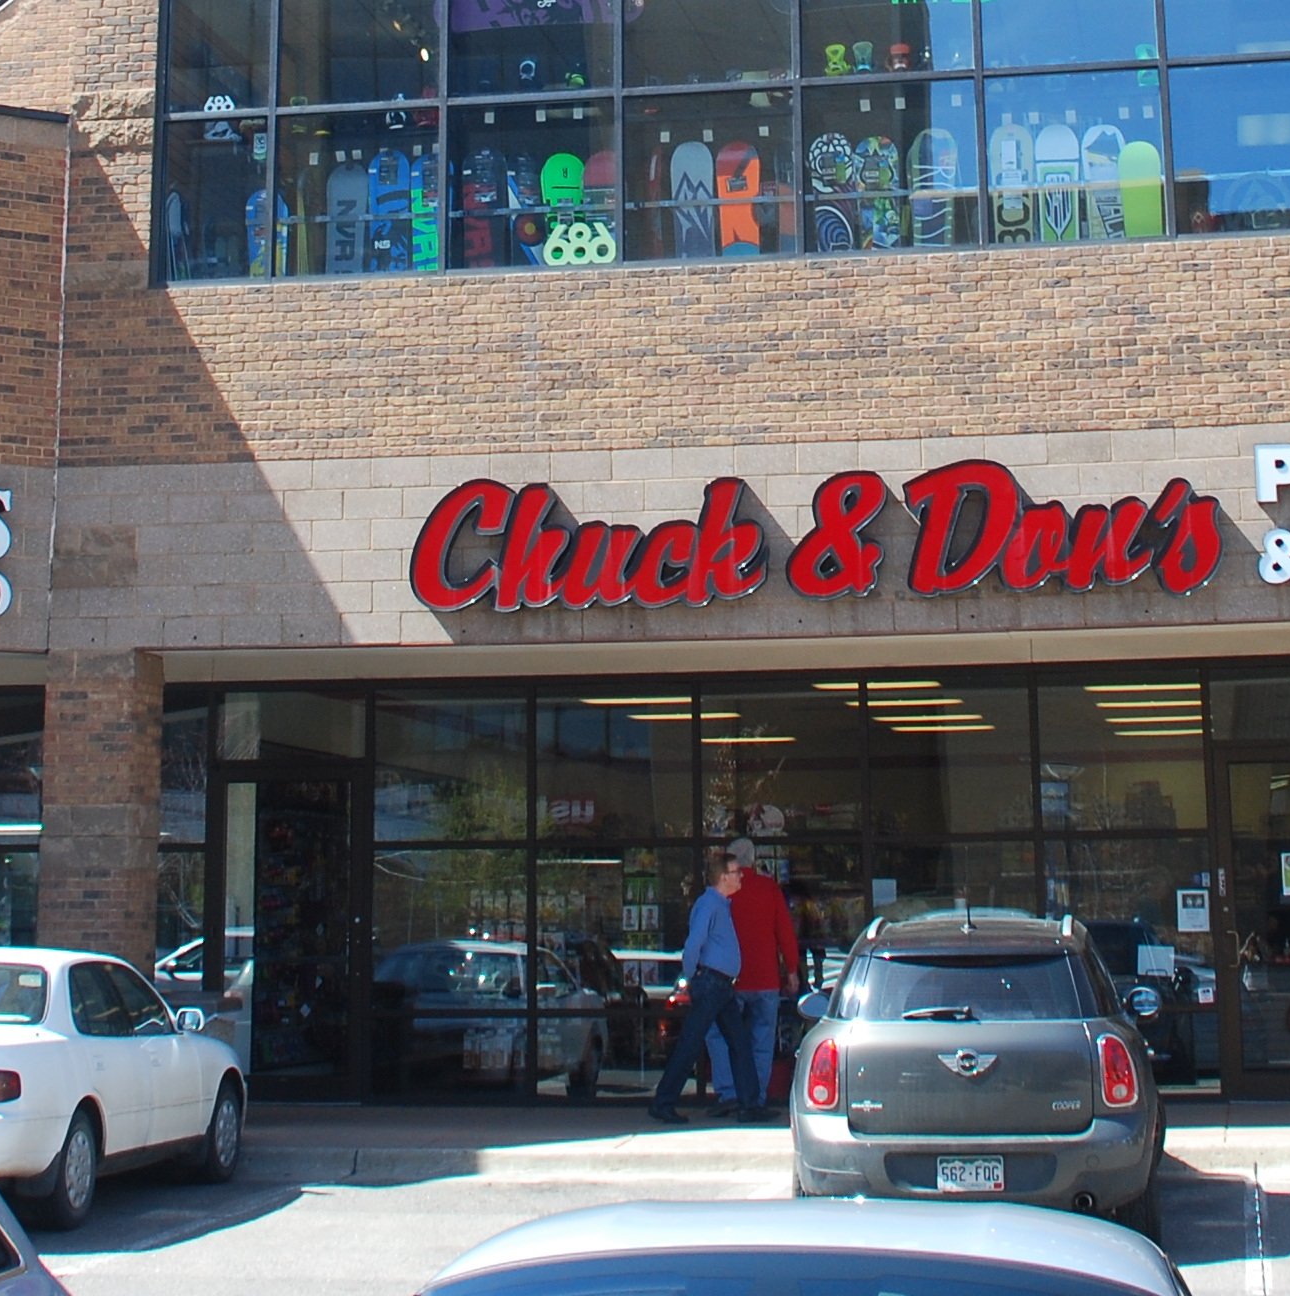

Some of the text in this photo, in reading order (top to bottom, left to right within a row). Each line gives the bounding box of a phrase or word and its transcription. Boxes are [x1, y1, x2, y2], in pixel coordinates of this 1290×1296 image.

[543, 222, 616, 266] 686
[410, 457, 1224, 613] Chuck & Don's
